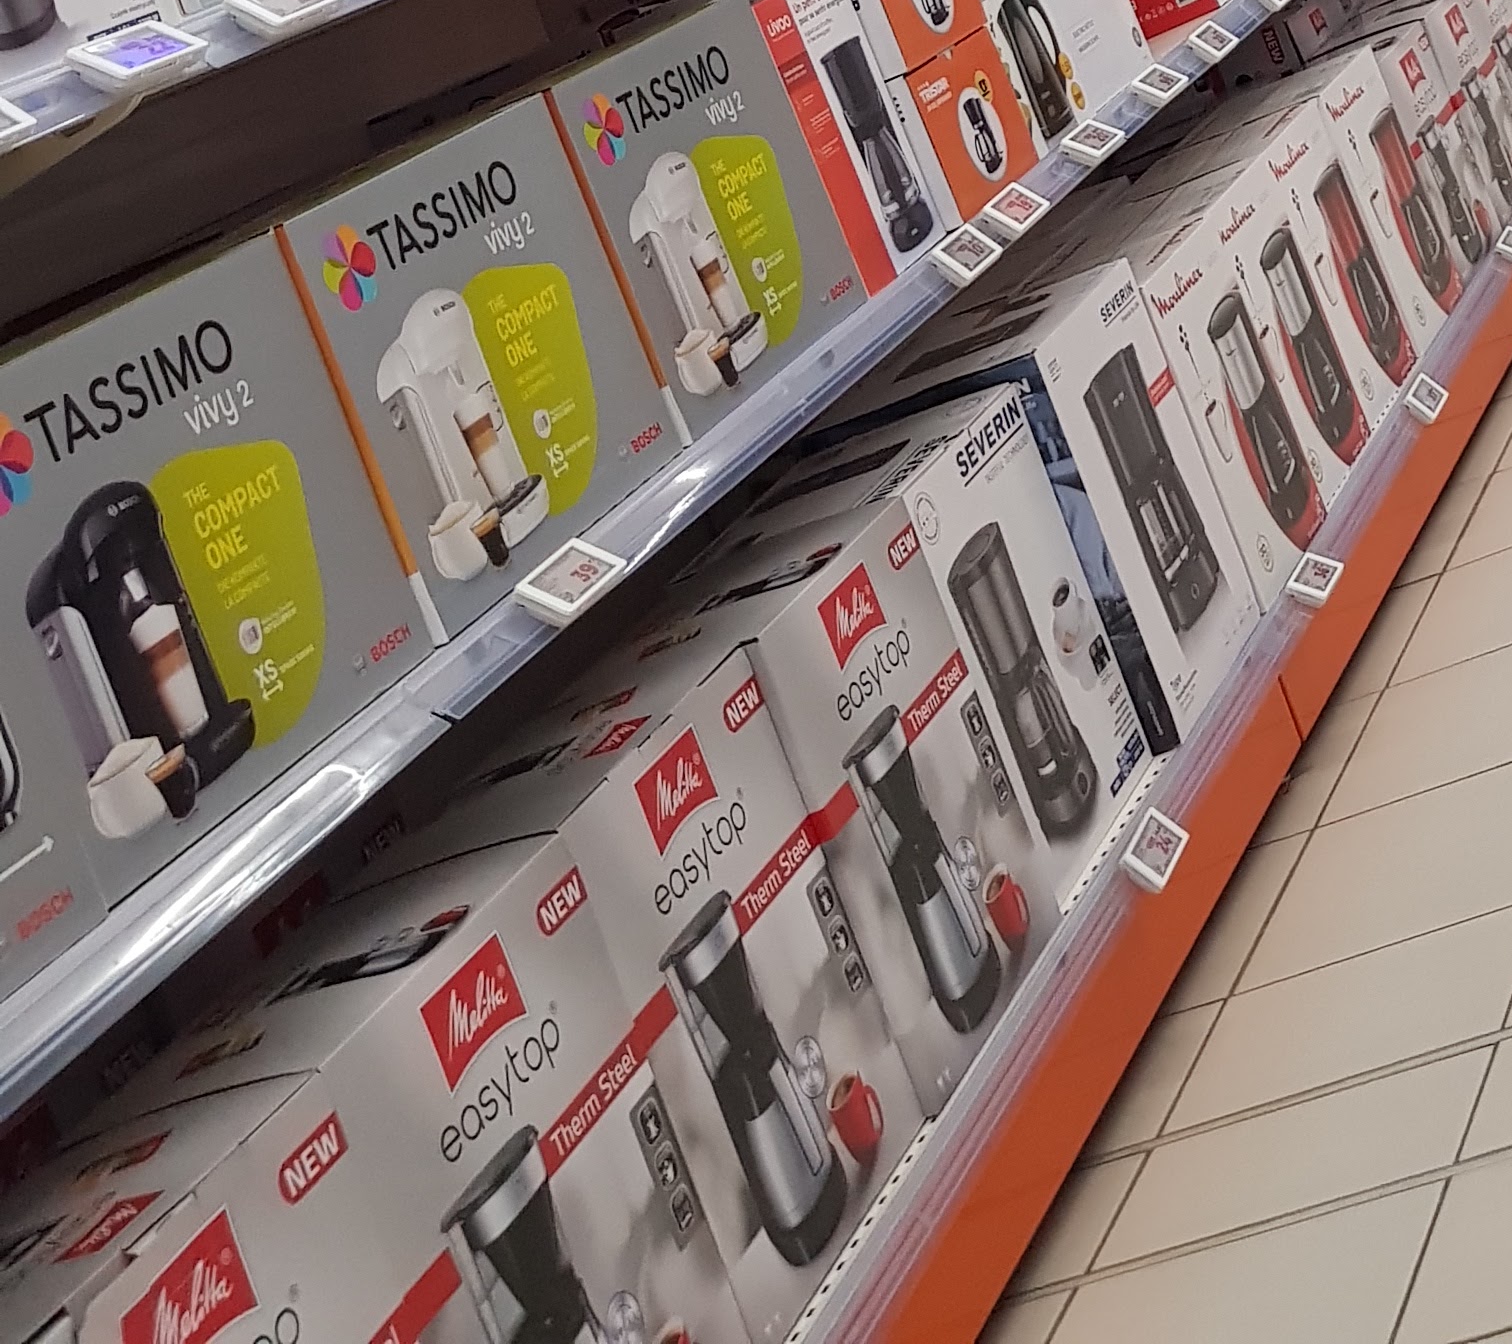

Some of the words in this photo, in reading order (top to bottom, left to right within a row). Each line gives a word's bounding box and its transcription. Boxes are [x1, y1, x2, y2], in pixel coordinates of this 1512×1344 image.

[615, 44, 730, 135] TASSIMO
[705, 97, 738, 127] vivy
[1329, 85, 1364, 123] Moulinex
[709, 158, 726, 177] THE
[717, 152, 769, 198] COMPACT
[1269, 142, 1310, 183] Moulinex
[366, 160, 518, 272] TASSIMO
[727, 190, 753, 221] ONE
[483, 221, 524, 257] vivy
[520, 211, 536, 235] 2
[488, 293, 509, 316] THE
[829, 275, 854, 302] BOSCH
[1099, 278, 1135, 324] SEVERIN
[1151, 268, 1205, 320] Moulinex
[494, 284, 561, 344] COMPACT
[505, 330, 538, 369] ONE
[23, 318, 235, 464] TASSIMO
[183, 392, 240, 436] vivy
[236, 379, 255, 408] 2
[544, 443, 567, 469] XS
[630, 420, 664, 453] BOSCH
[955, 396, 1022, 478] SEVERIN
[183, 481, 211, 509] THE
[193, 464, 282, 540] COMPACT
[205, 523, 249, 570] ONE
[889, 529, 918, 568] NEW
[834, 587, 882, 644] Melitta
[369, 624, 413, 663] BOSCH
[252, 657, 280, 690] XS
[836, 628, 912, 722] easytop
[906, 691, 938, 732] Therm
[936, 659, 965, 702] Steel
[725, 683, 761, 729] NEW
[655, 748, 706, 814] Melitta
[652, 797, 748, 916] easytop
[741, 869, 779, 920] Therm
[777, 830, 814, 881] Steel
[539, 872, 584, 936] NEW
[446, 986, 509, 1058] Melitta
[439, 1016, 562, 1164] easytop
[549, 1092, 600, 1158] Therm
[596, 1042, 640, 1107] Steel
[282, 1123, 341, 1196] NEW
